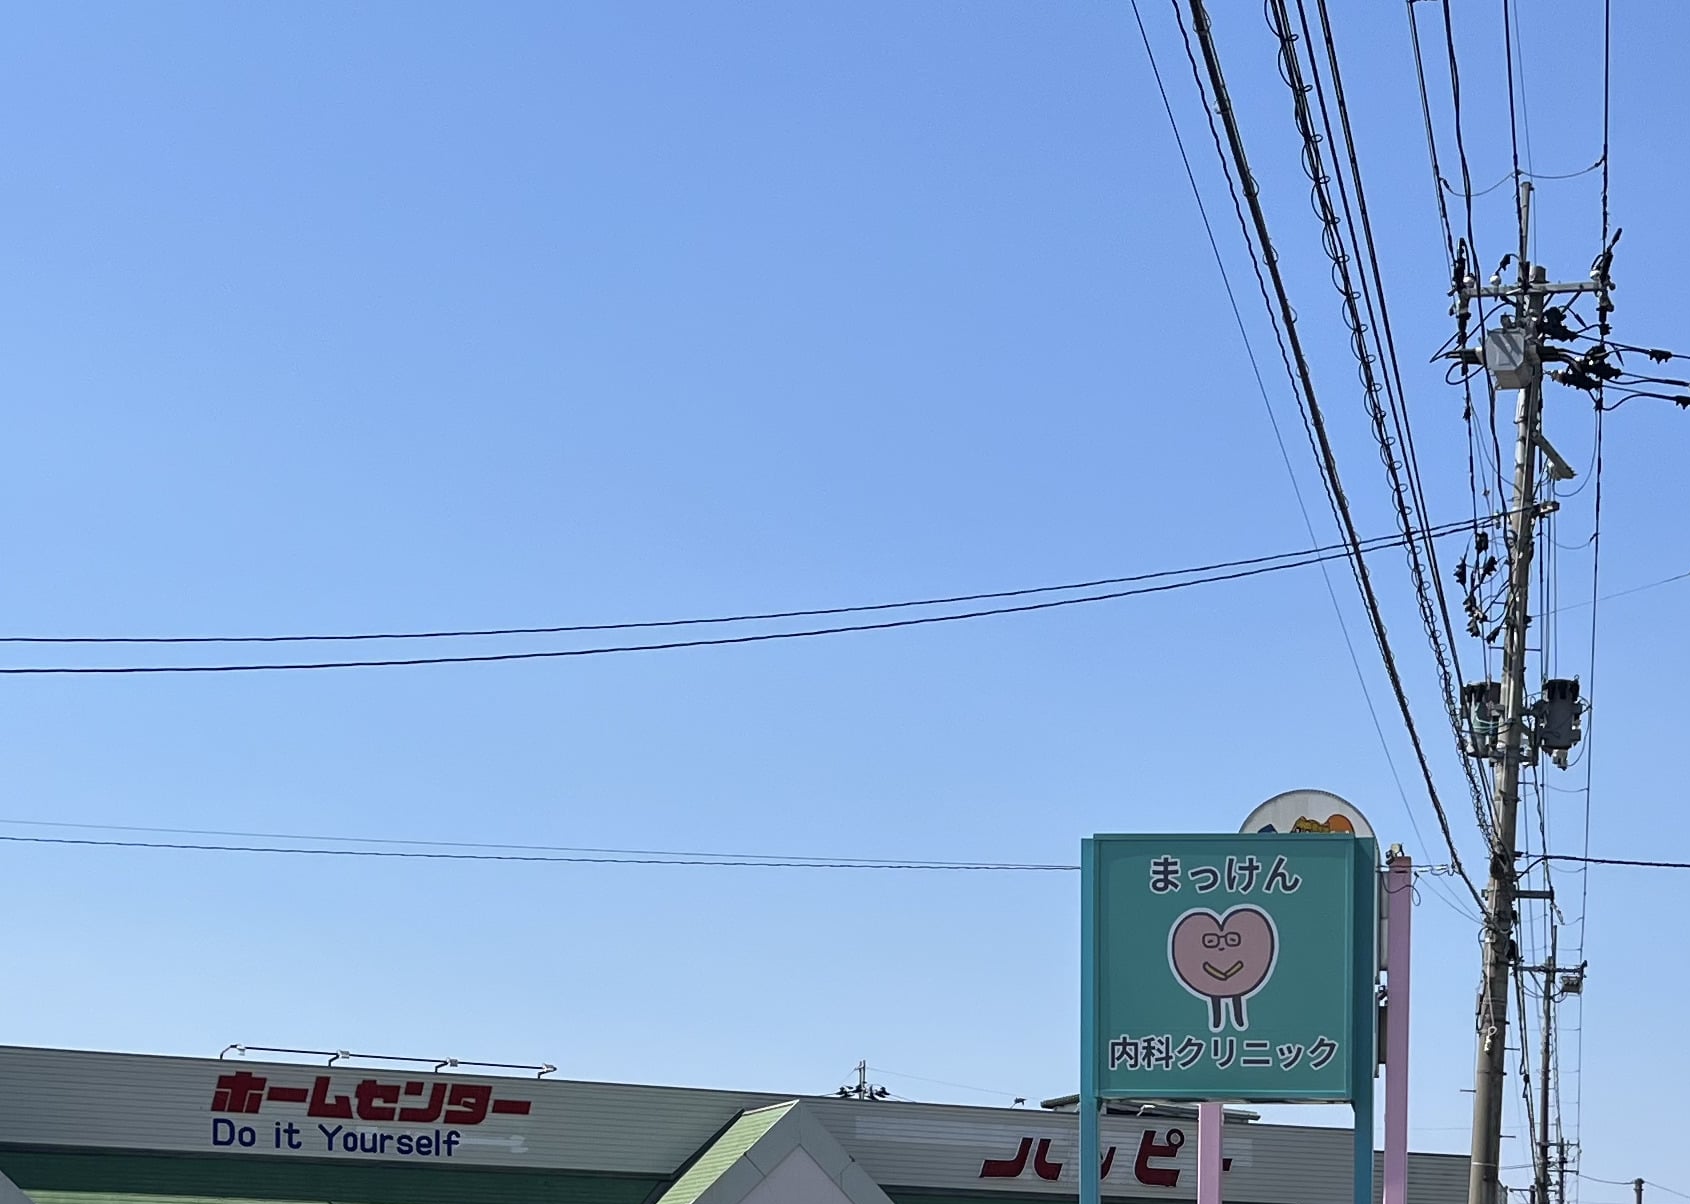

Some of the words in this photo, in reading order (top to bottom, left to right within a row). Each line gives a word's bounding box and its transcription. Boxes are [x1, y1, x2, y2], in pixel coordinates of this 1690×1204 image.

[1149, 855, 1302, 894] まっけん
[1108, 1036, 1338, 1071] 内科クリニック
[210, 1071, 532, 1126] ホームセンター
[211, 1118, 257, 1147] Do
[274, 1121, 302, 1149] it
[317, 1123, 461, 1156] Yourself
[979, 1128, 1233, 1187] ハピ
